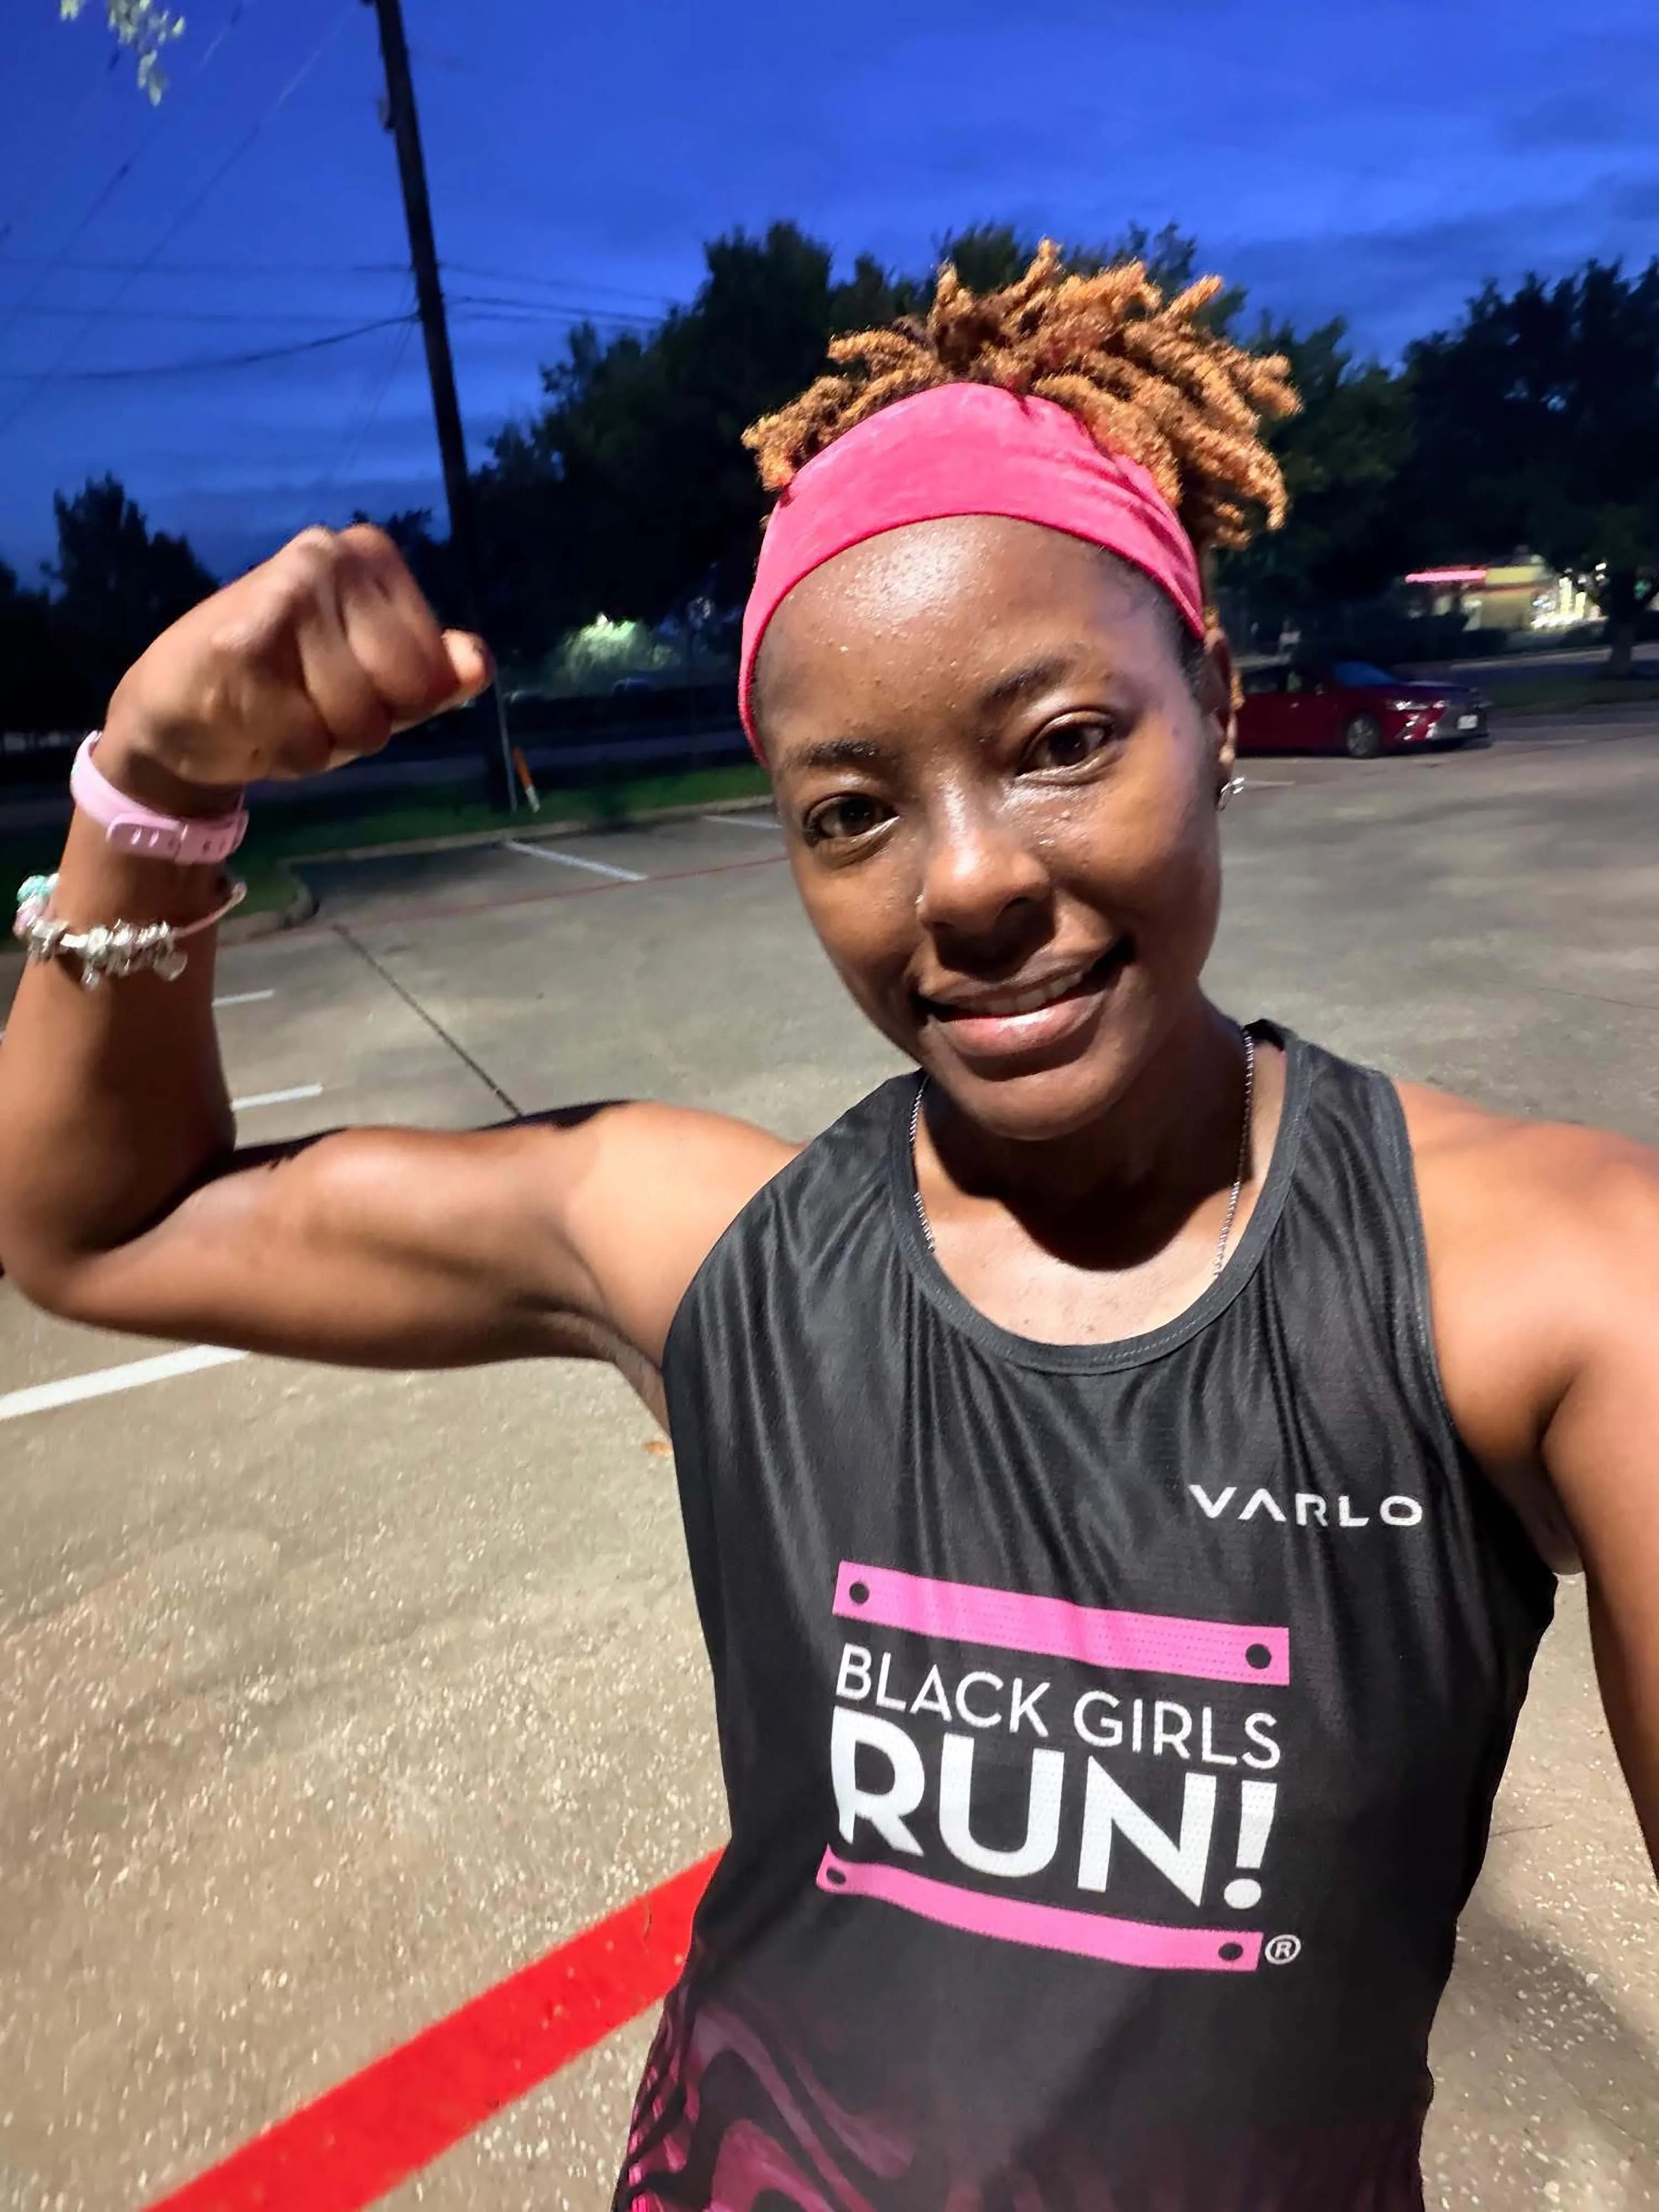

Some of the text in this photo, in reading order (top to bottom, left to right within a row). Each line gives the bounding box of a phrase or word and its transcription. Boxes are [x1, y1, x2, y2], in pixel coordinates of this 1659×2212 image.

[1189, 1484, 1423, 1527] VARLO
[836, 1643, 1281, 1768] BLACK GIRLS
[831, 1705, 1277, 1909] RUN!
